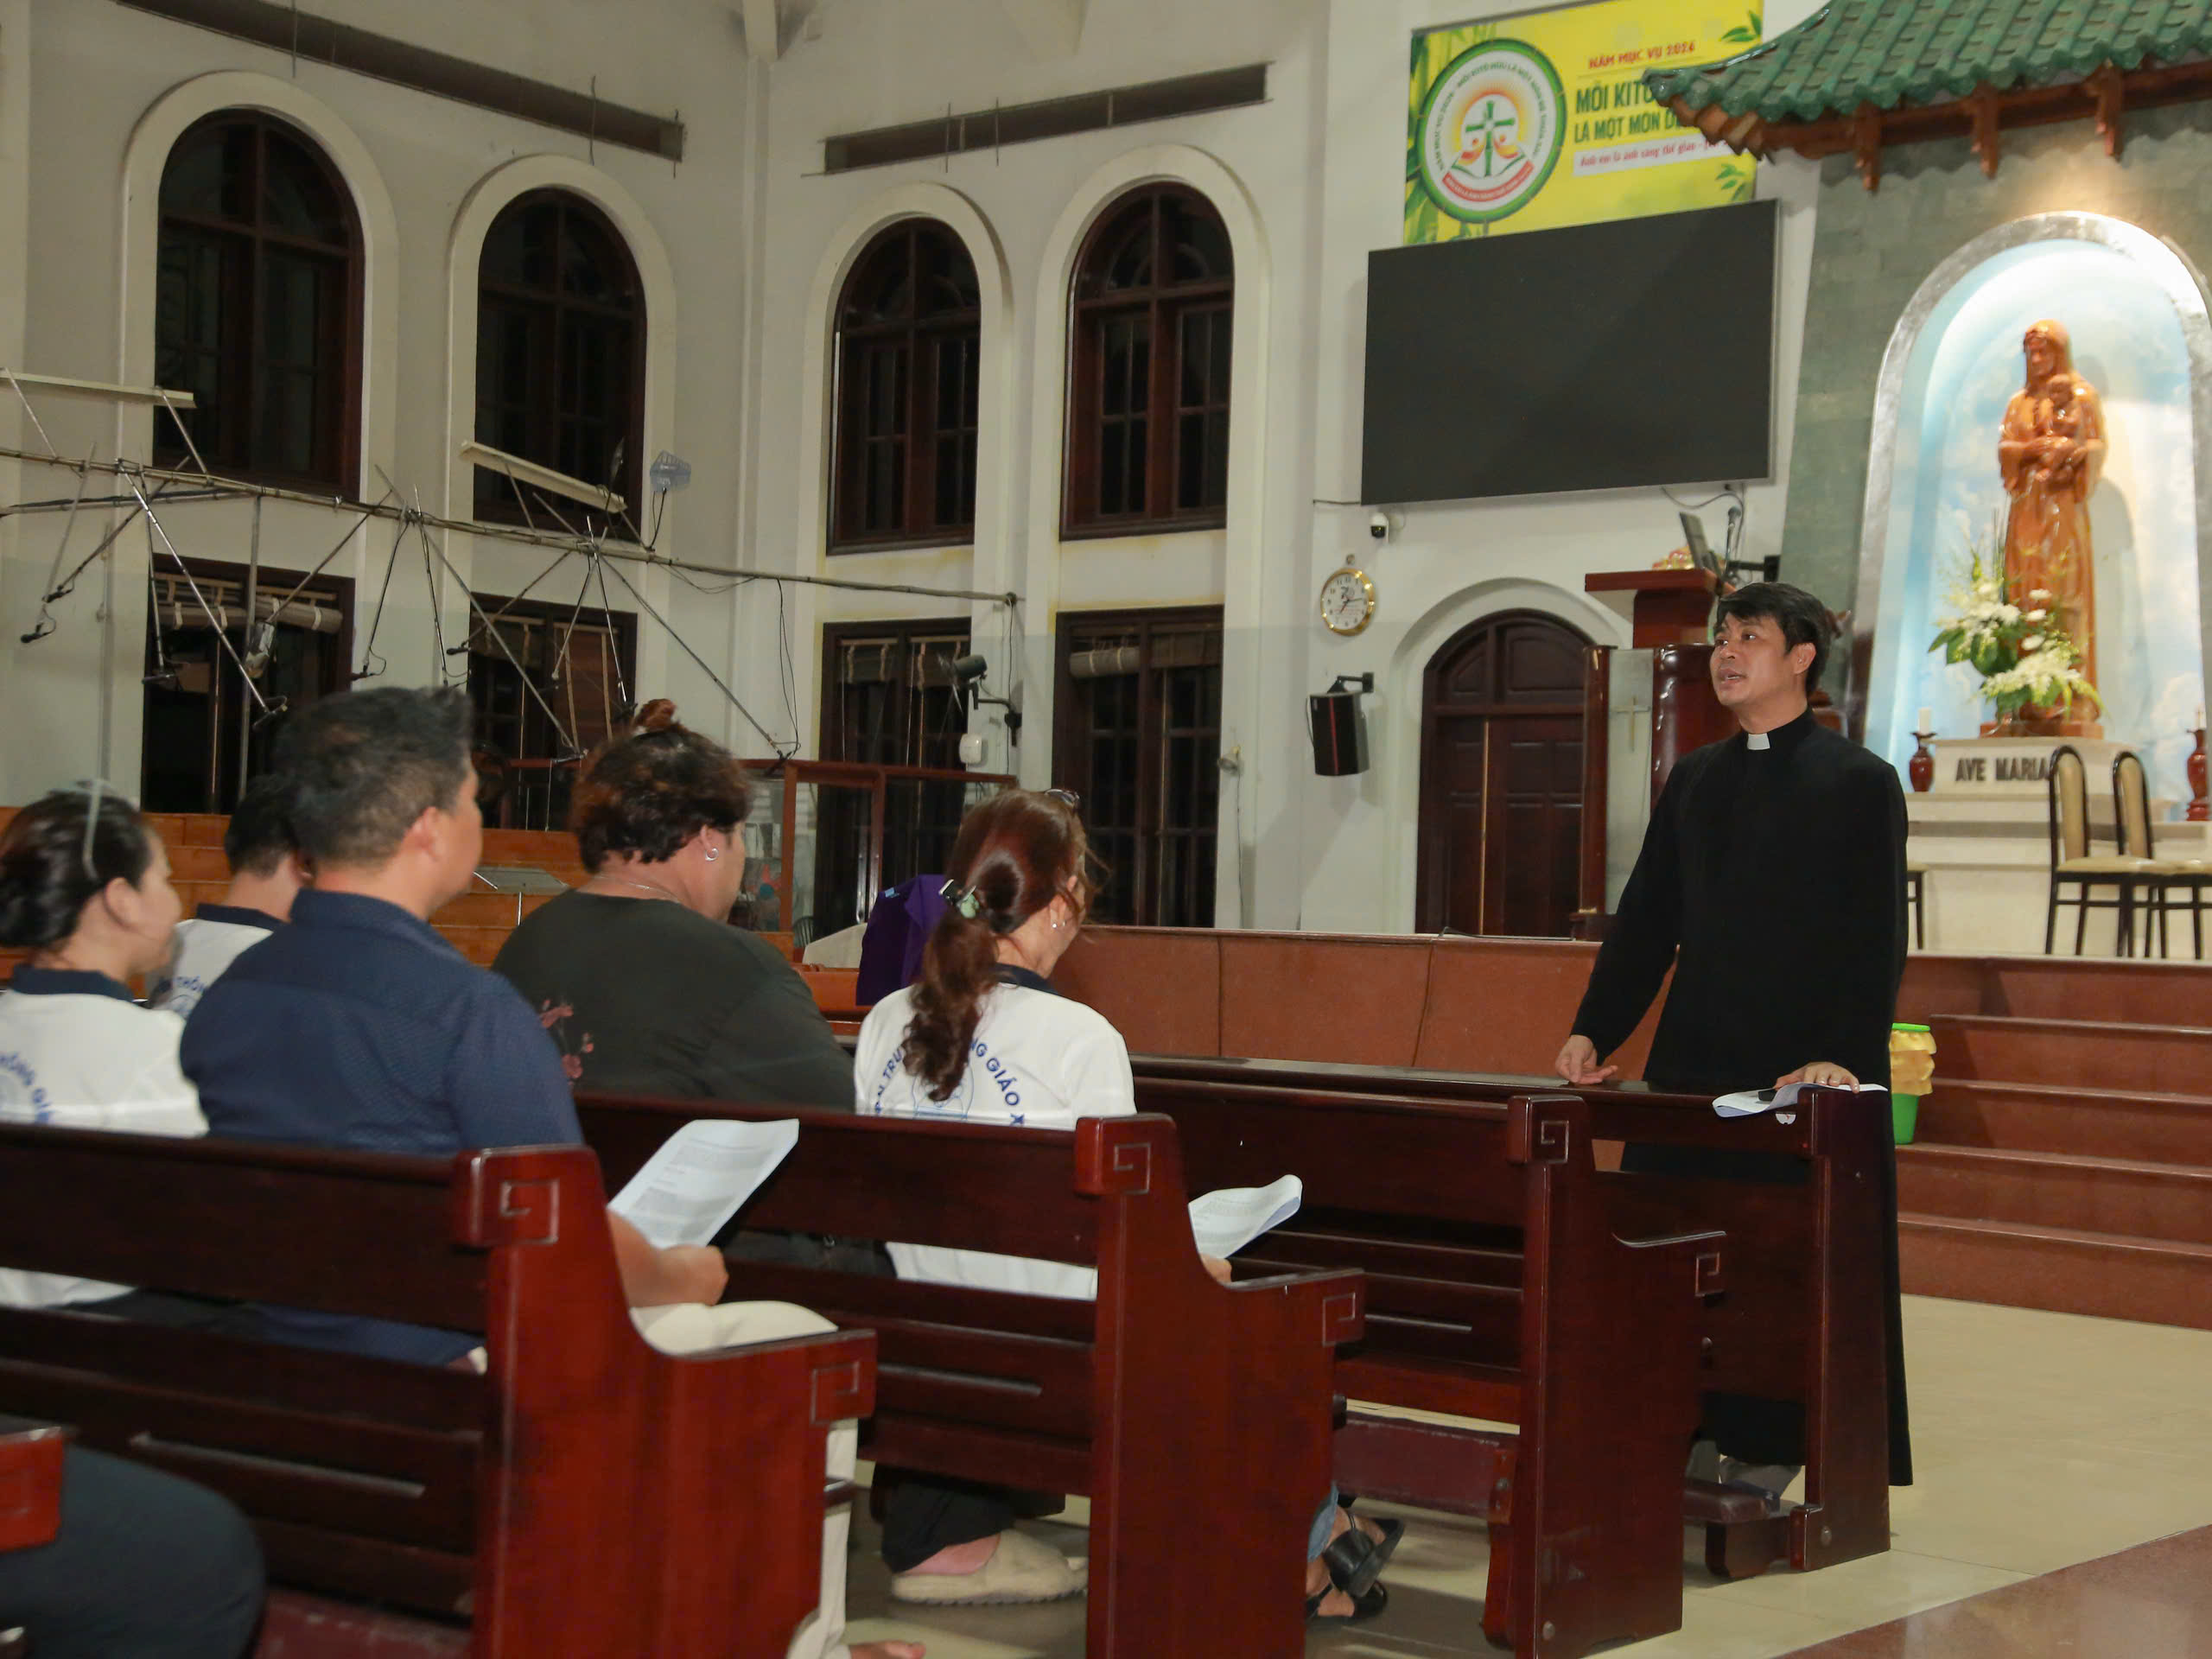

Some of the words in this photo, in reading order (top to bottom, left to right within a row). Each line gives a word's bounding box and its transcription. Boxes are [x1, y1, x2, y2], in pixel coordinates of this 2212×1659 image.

[1666, 41, 1695, 56] 2024
[1995, 757, 2050, 782] MARIA
[882, 1047, 905, 1080] TRU
[985, 1057, 1020, 1107] GIÁO
